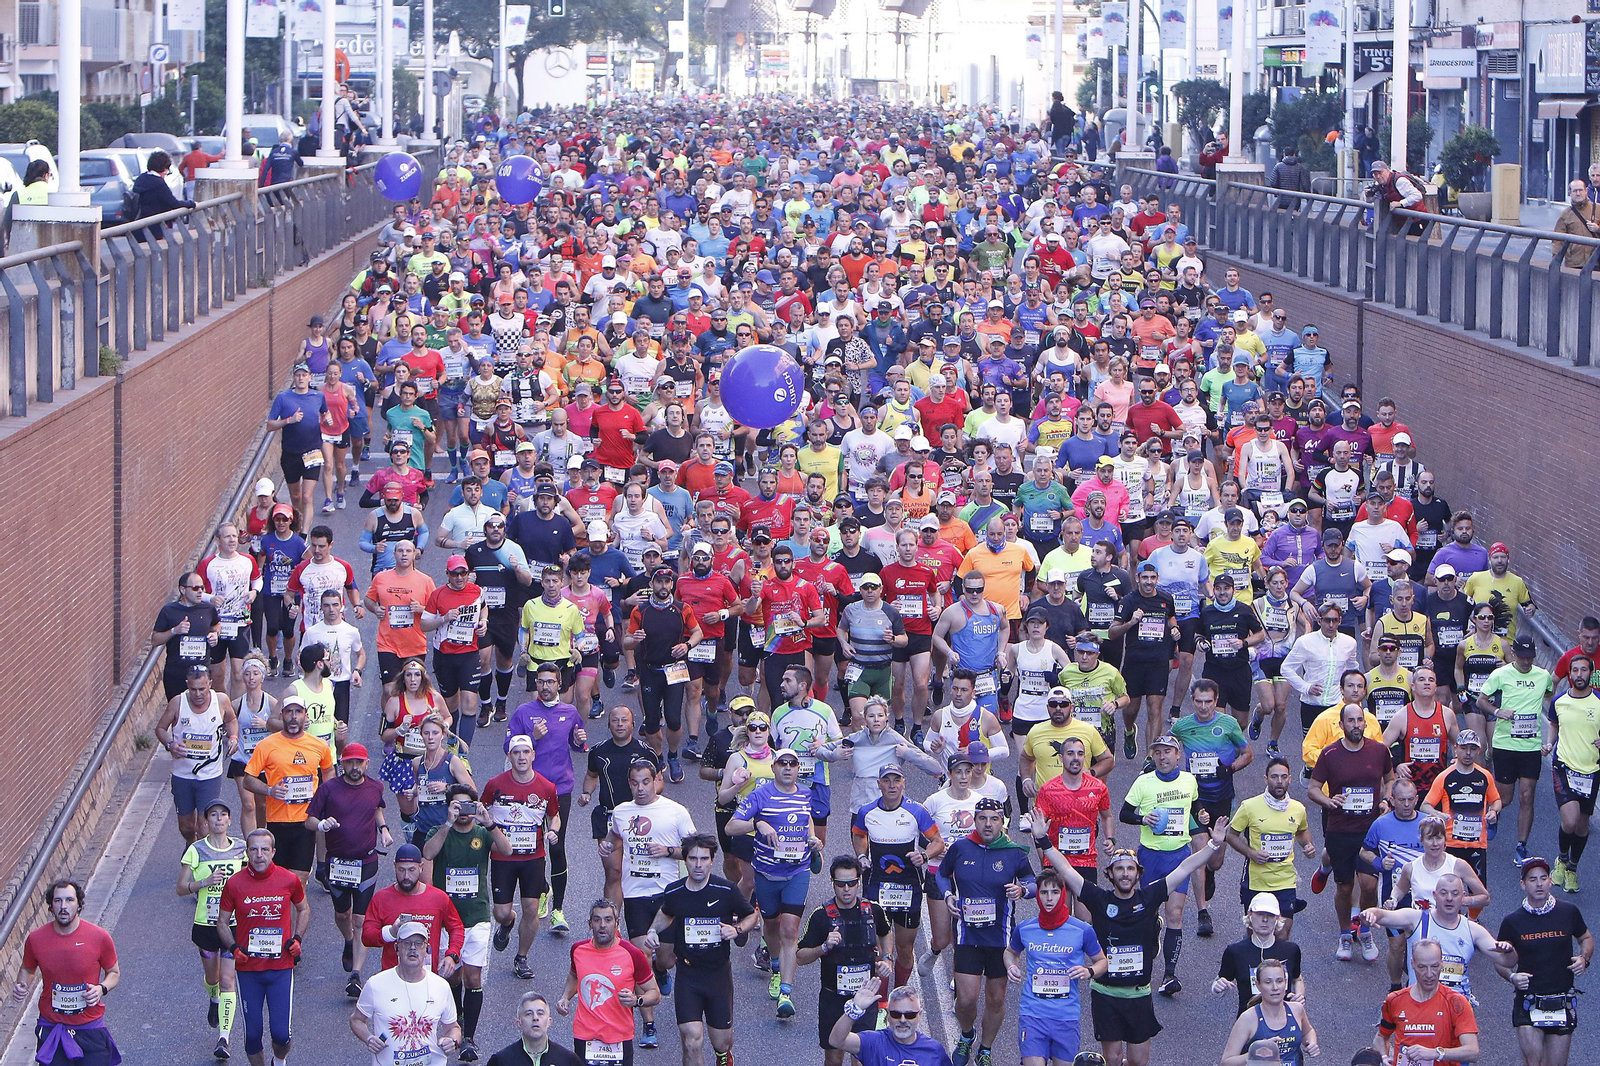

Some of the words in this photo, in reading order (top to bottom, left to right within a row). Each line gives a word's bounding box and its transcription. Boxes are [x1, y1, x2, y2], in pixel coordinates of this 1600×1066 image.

[400, 166, 418, 182] ZURICH
[782, 371, 796, 406] ZURICH
[459, 606, 478, 615] HERE
[1520, 931, 1565, 940] MERRELL
[1028, 942, 1074, 954] ProFuturo
[223, 999, 232, 1030] Kalenji
[406, 1048, 428, 1058] ZURICH
